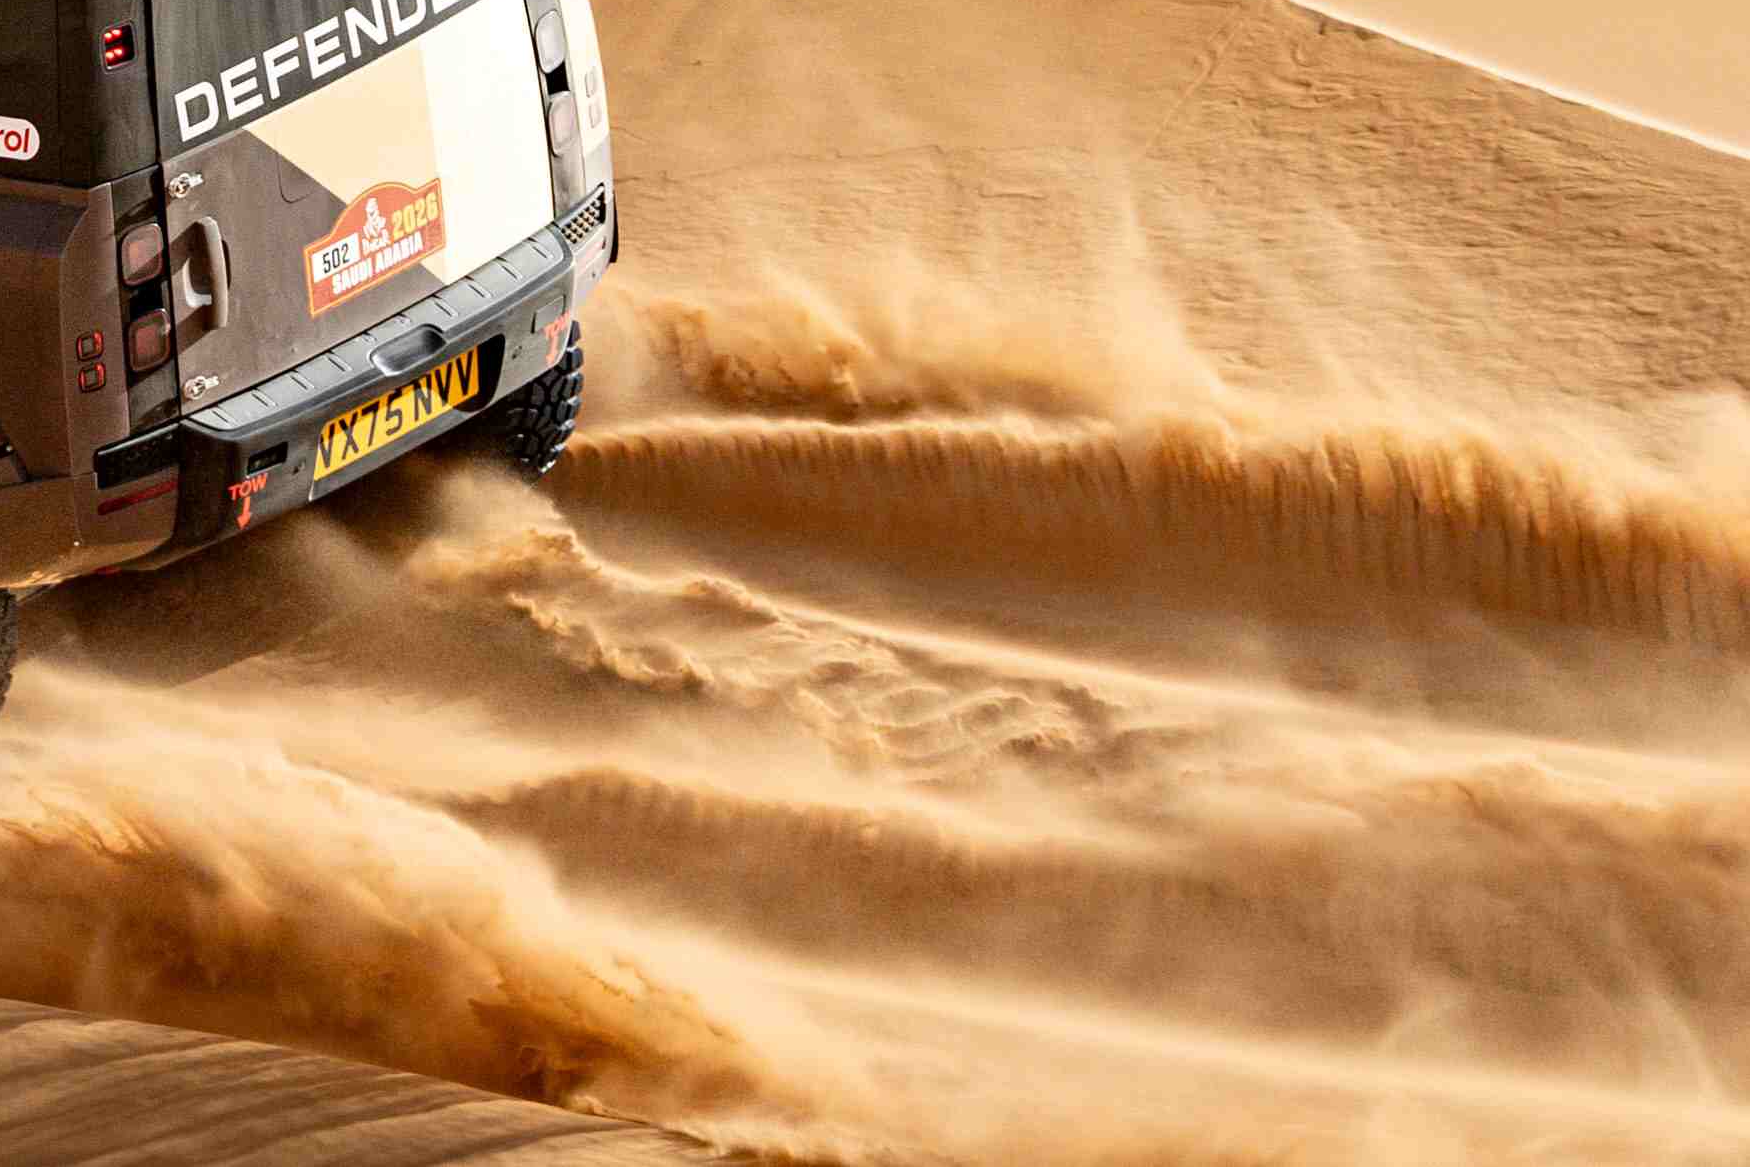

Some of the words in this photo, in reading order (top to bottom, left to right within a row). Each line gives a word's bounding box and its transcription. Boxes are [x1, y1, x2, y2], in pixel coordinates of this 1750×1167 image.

[392, 191, 439, 242] 2026
[322, 242, 351, 275] 502
[332, 257, 373, 295] SAUDI
[375, 230, 424, 274] ARABIA
[318, 386, 402, 469] VX75
[411, 349, 474, 422] NVV
[228, 472, 268, 502] TOW
